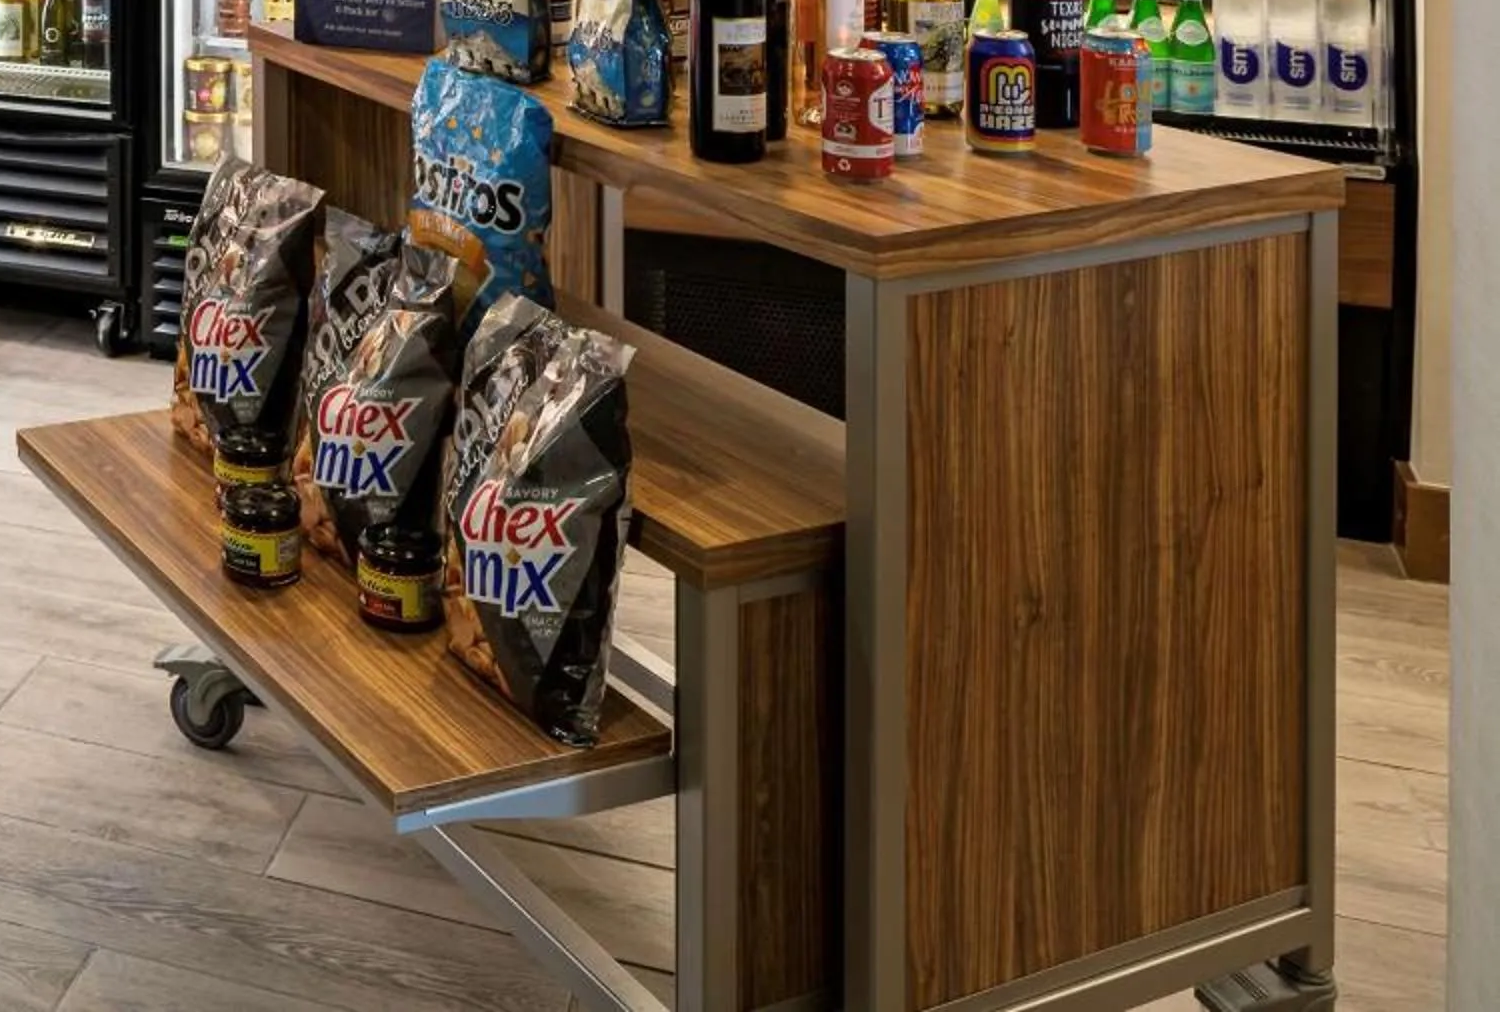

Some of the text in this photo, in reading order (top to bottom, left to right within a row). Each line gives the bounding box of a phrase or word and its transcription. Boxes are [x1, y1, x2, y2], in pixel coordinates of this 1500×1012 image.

[980, 115, 1035, 131] HAZE
[191, 299, 271, 349] Chex
[193, 351, 261, 400] mix
[319, 385, 414, 443] Chex
[316, 442, 403, 495] mix
[462, 481, 576, 549] Chex
[468, 547, 565, 613] mix
